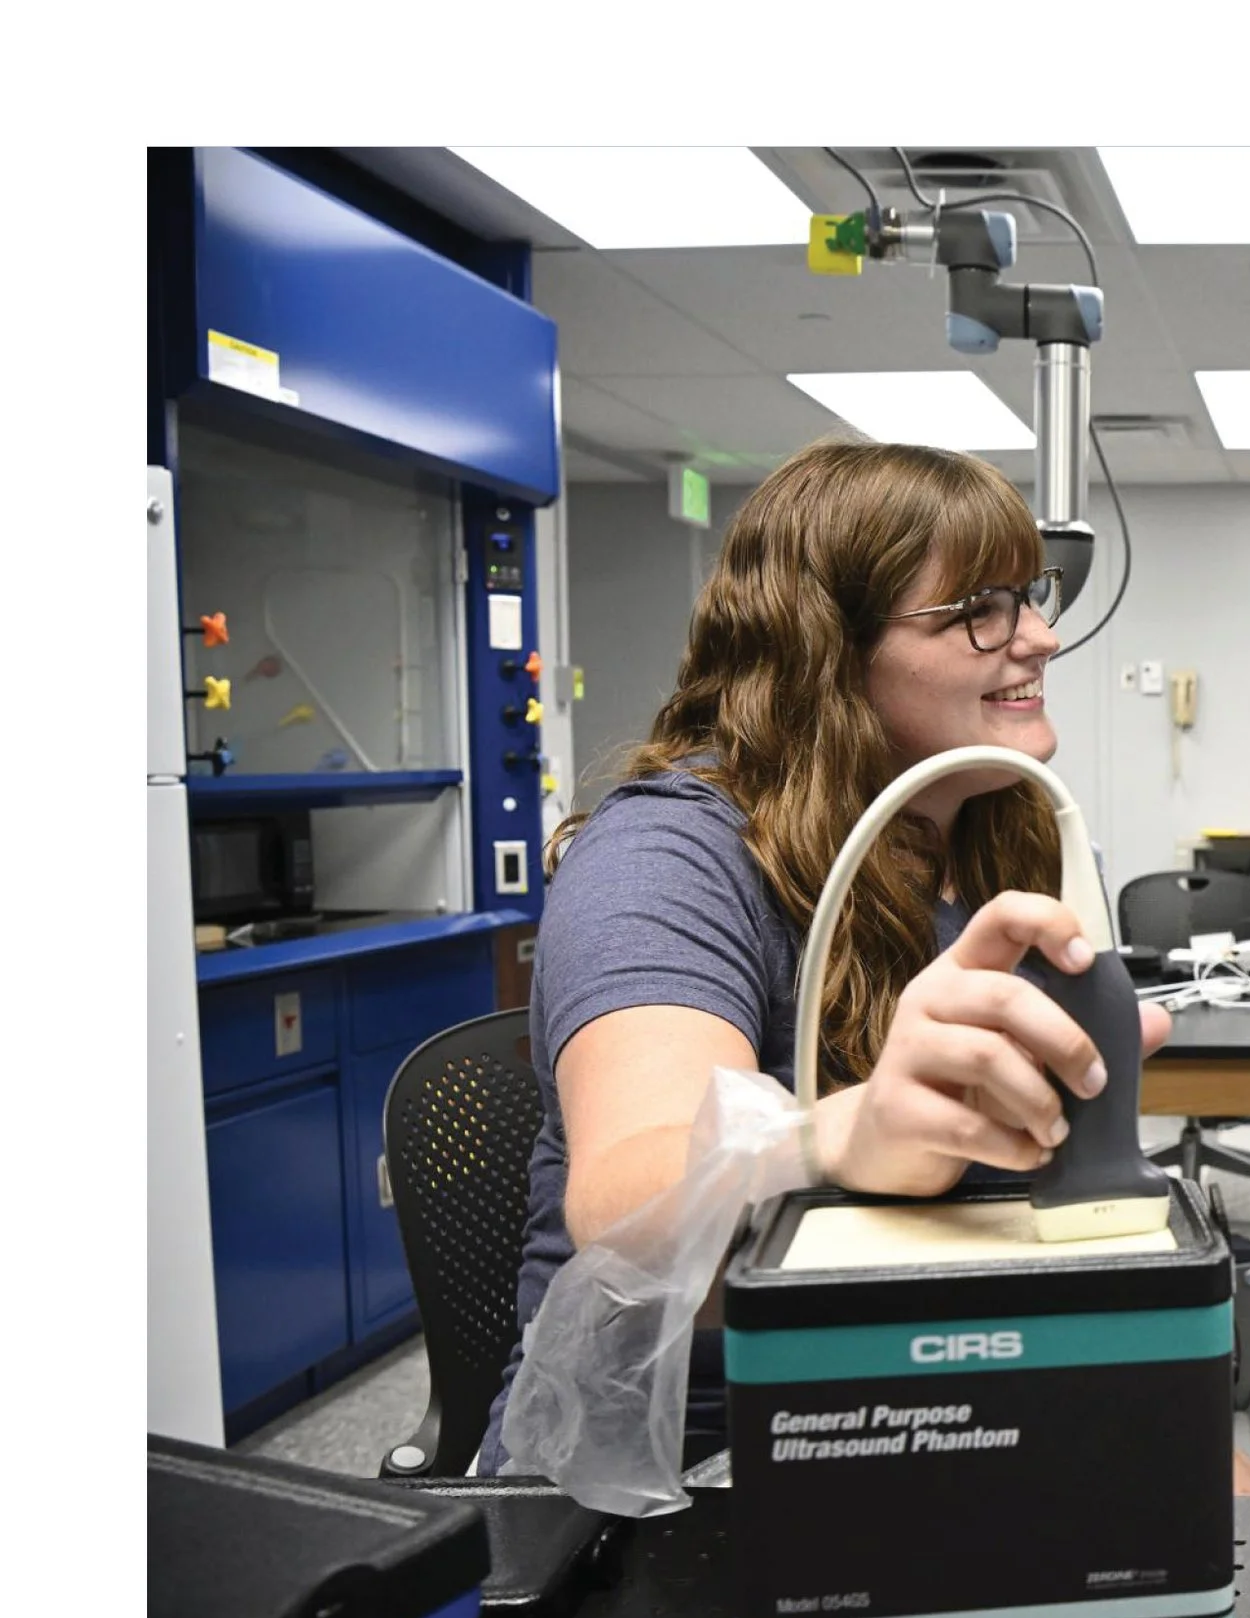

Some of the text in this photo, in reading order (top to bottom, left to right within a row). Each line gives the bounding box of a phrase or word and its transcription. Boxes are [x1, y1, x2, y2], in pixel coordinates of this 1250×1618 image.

[910, 1331, 1023, 1363] CIRS
[771, 1403, 973, 1435] General Purpose
[772, 1426, 1020, 1462] Ultrasound Phantom
